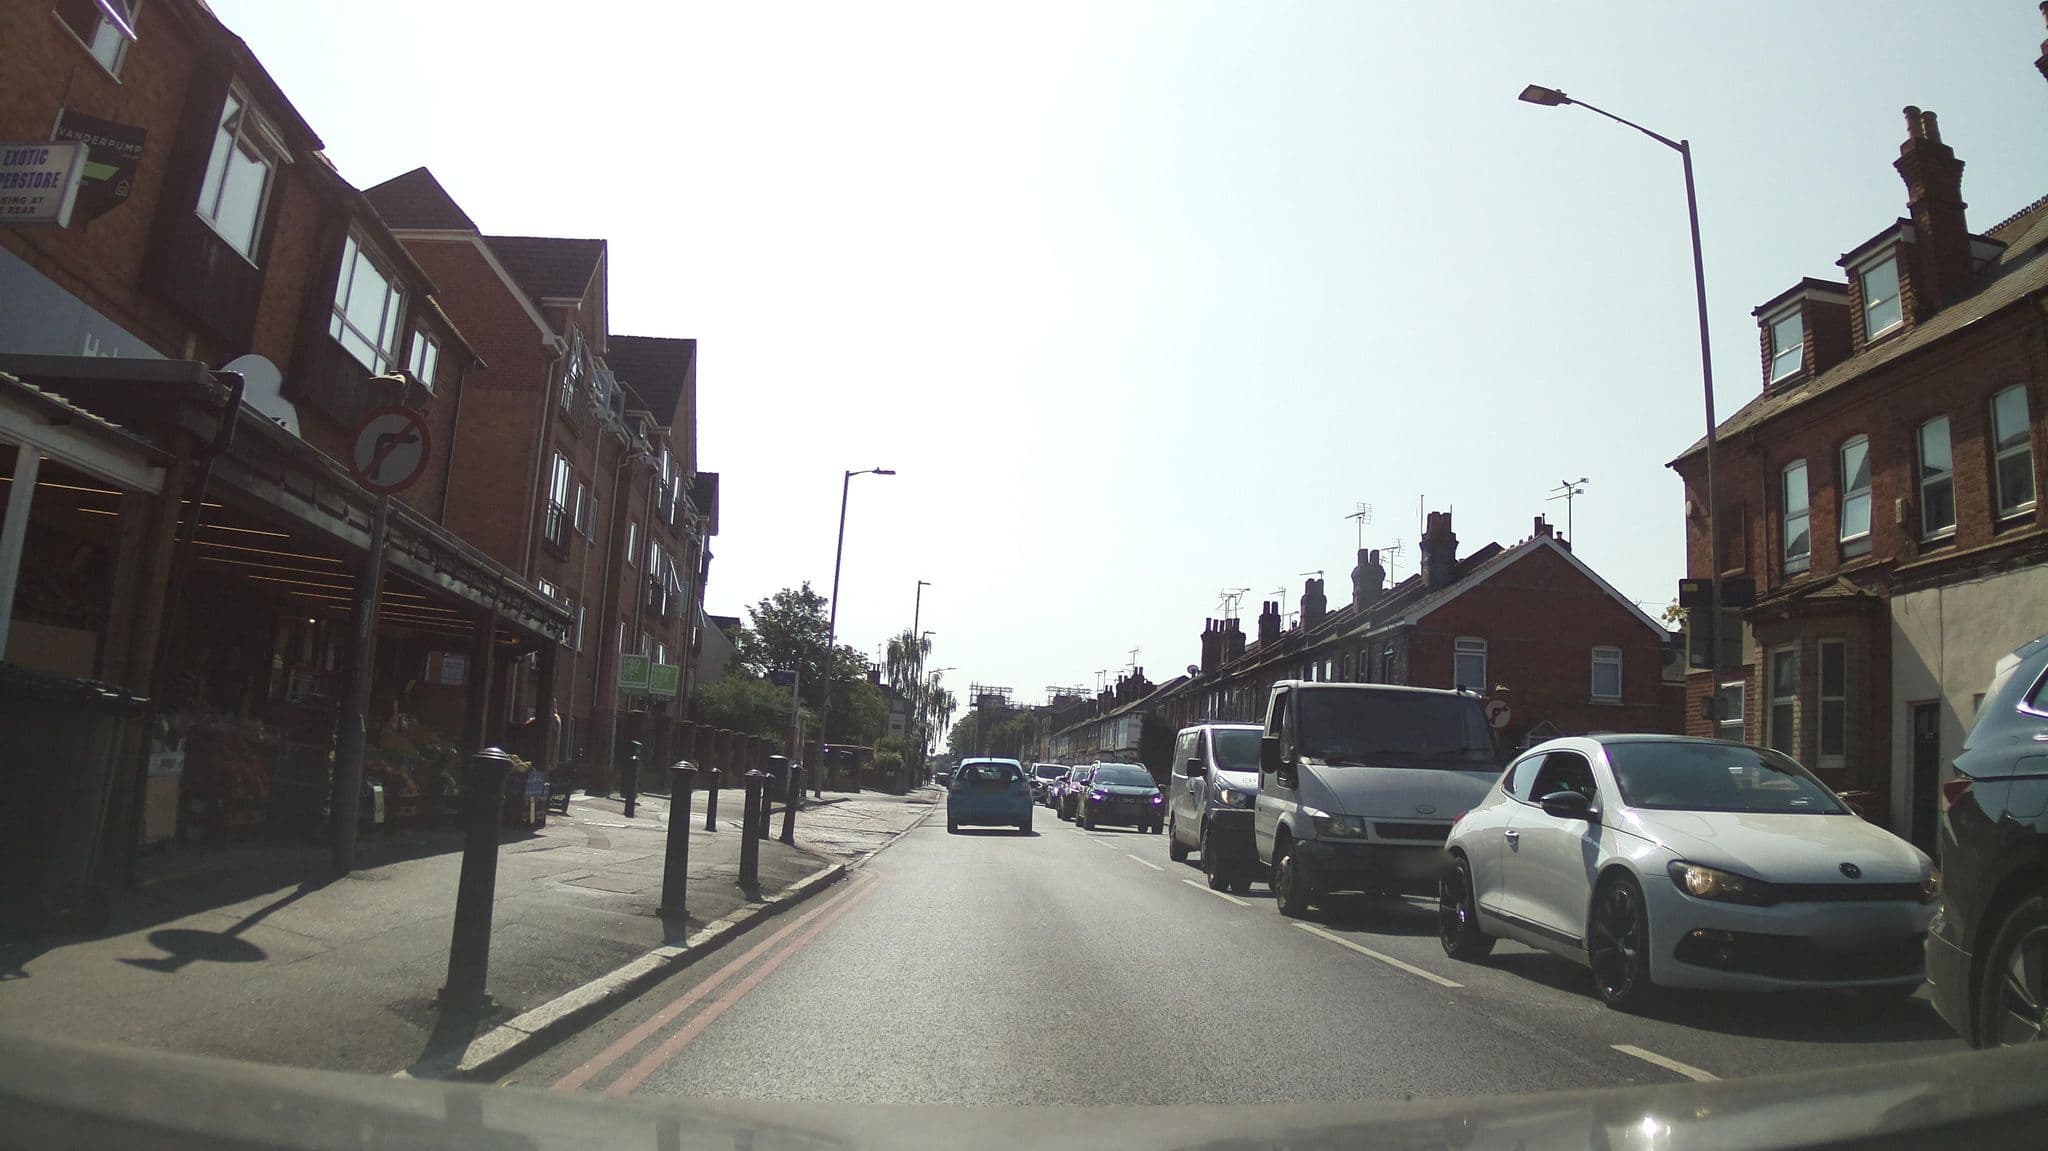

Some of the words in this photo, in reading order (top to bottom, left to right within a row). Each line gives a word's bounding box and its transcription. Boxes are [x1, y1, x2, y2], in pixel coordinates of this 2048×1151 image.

[58, 127, 143, 153] VANDERPUMP
[4, 149, 49, 166] EXOTIC
[30, 196, 46, 205] AT
[7, 206, 37, 215] REAR
